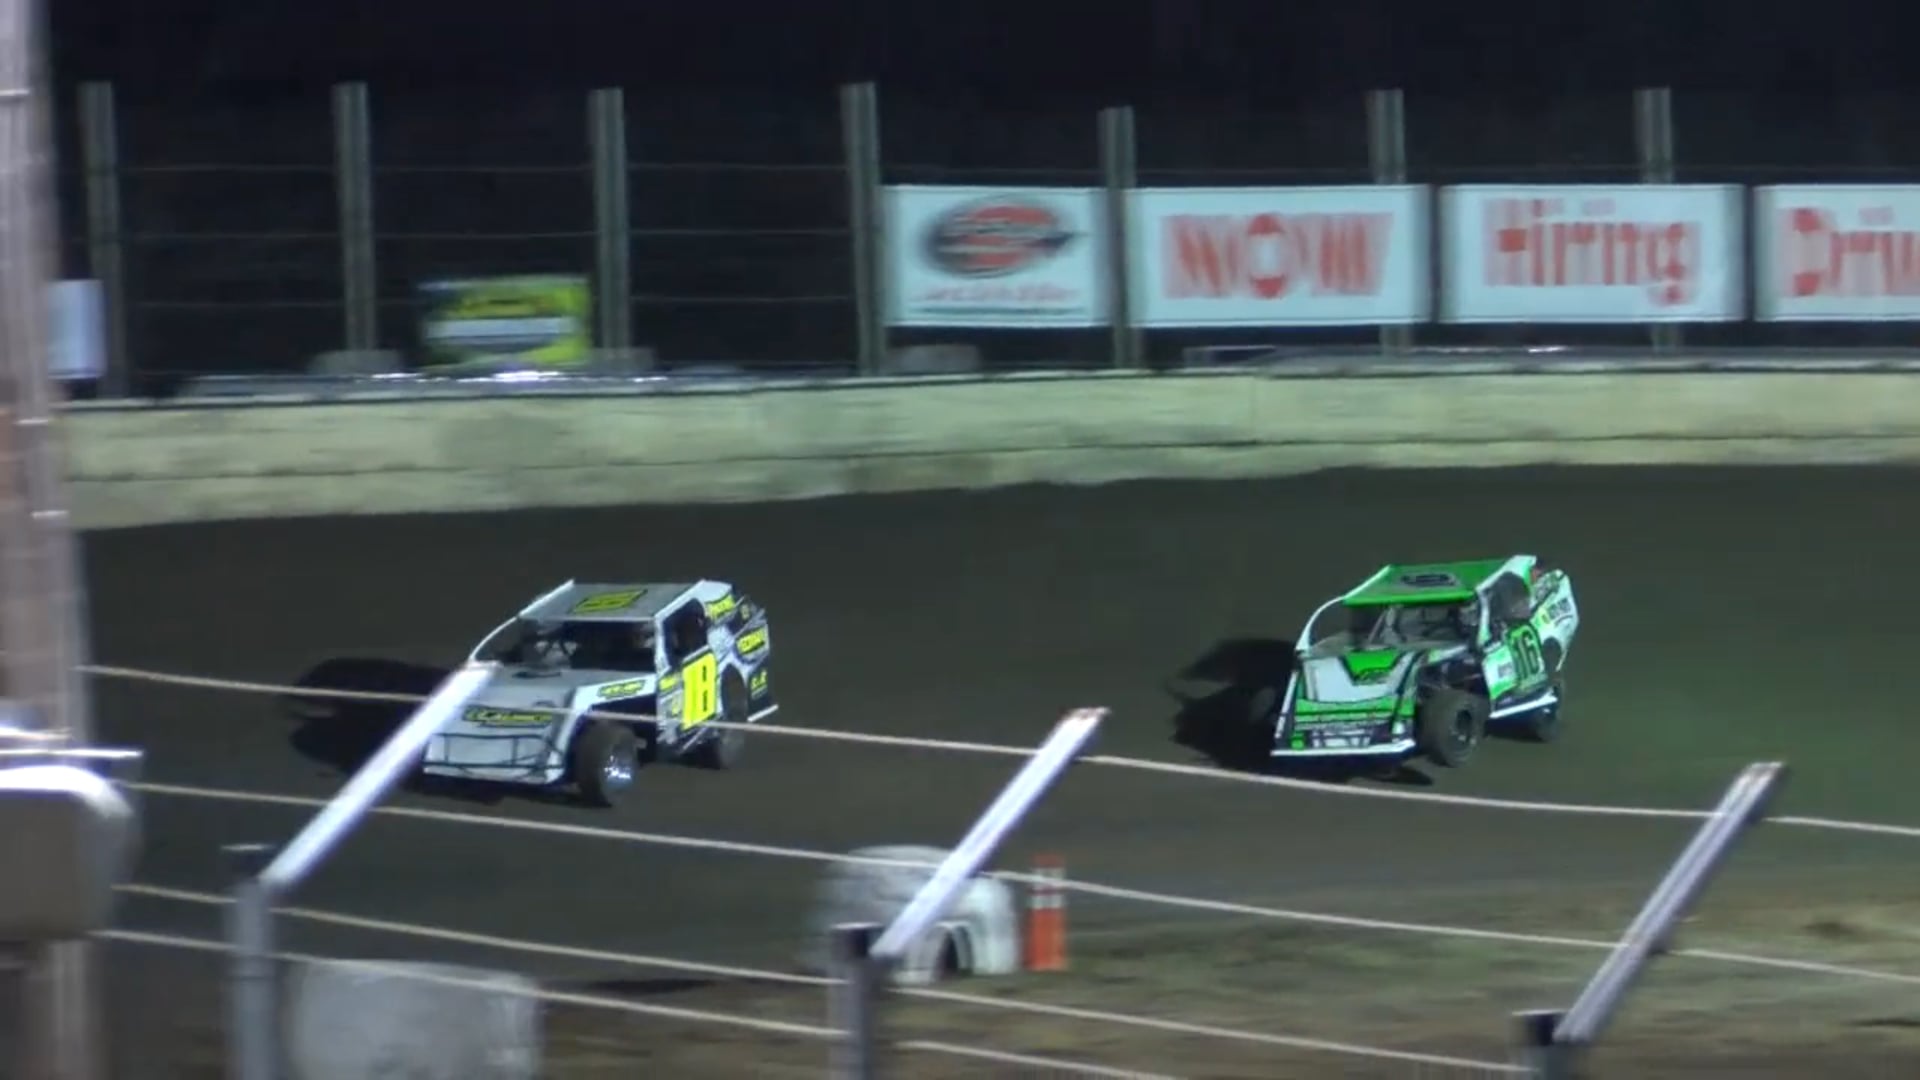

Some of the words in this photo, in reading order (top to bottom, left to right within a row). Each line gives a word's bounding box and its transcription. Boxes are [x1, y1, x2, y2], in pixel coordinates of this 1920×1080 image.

[1162, 213, 1393, 298] NOW
[1483, 198, 1700, 305] Hiring
[682, 652, 717, 731] 18
[1506, 627, 1541, 680] 16
